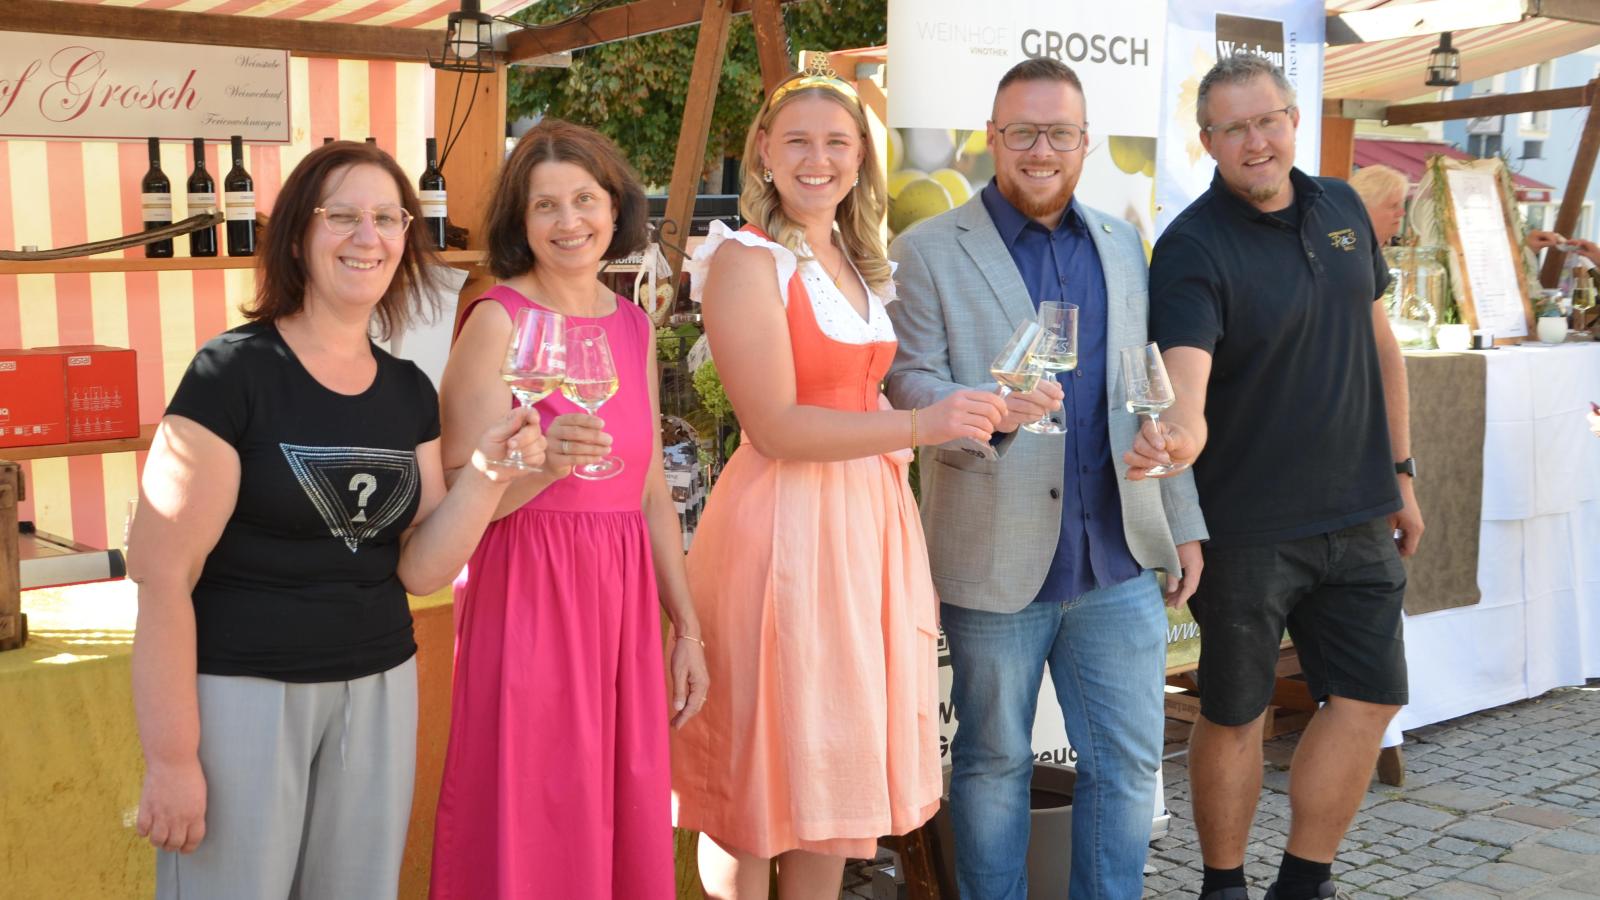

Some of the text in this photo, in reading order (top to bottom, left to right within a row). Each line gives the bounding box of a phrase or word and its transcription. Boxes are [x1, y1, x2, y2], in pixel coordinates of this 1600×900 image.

[916, 21, 1149, 66] WEINHOF GROSCH
[969, 46, 1009, 57] VINOTHEK
[1217, 40, 1283, 67] Weibau
[235, 55, 280, 70] Weinstube
[39, 46, 201, 122] Grosch
[225, 84, 283, 101] Weinverkauf
[201, 112, 281, 129] Ferienwohnungen
